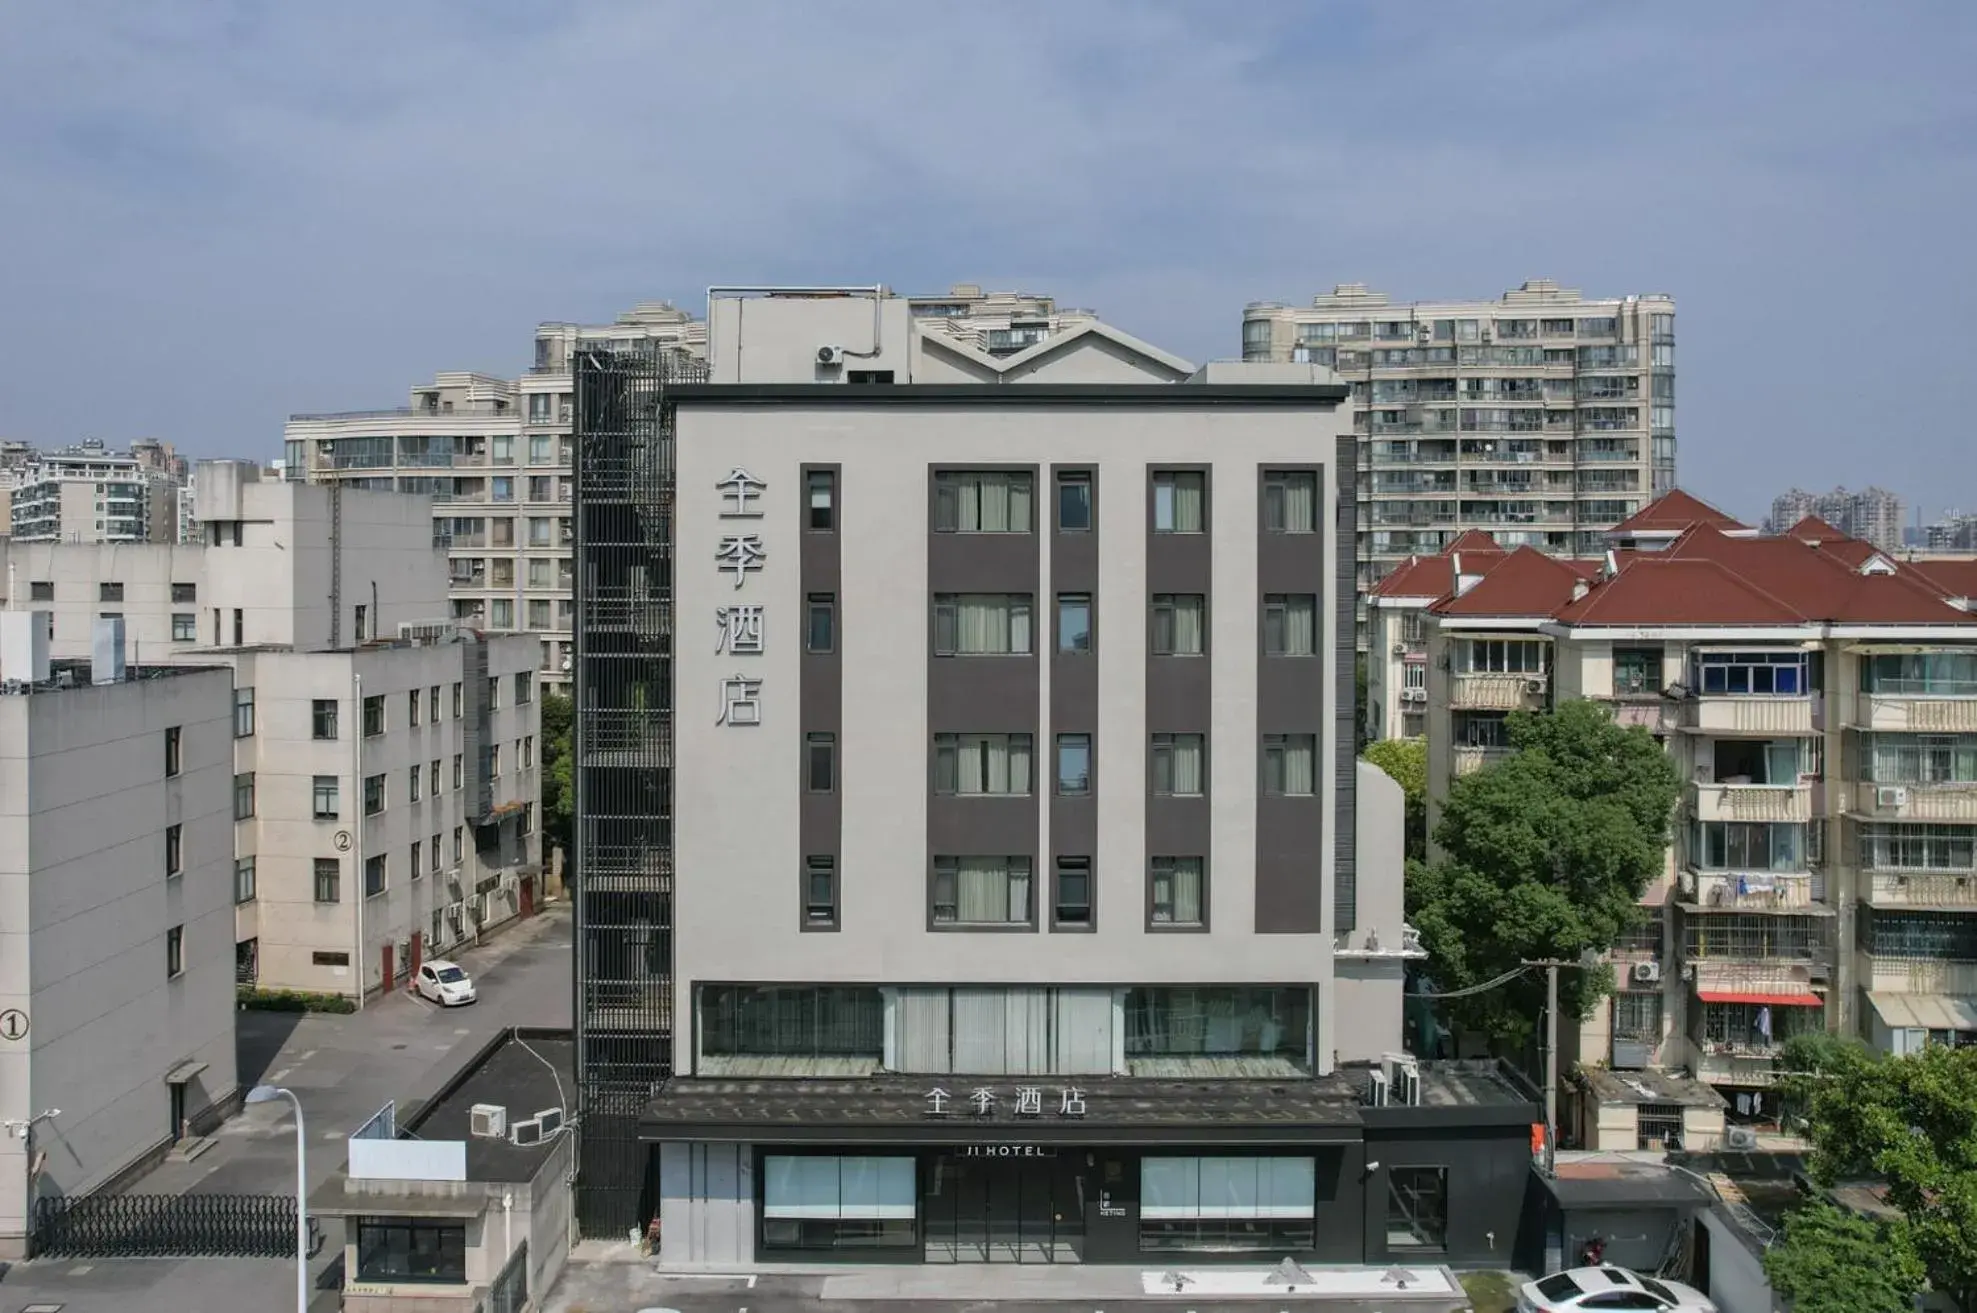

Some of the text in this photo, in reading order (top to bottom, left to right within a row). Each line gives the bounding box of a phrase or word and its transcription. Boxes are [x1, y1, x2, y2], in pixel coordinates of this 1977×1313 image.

[715, 465, 767, 728] 全季酒店
[924, 1086, 1087, 1115] 全季酒店
[967, 1146, 1045, 1156] JI HOTEL
